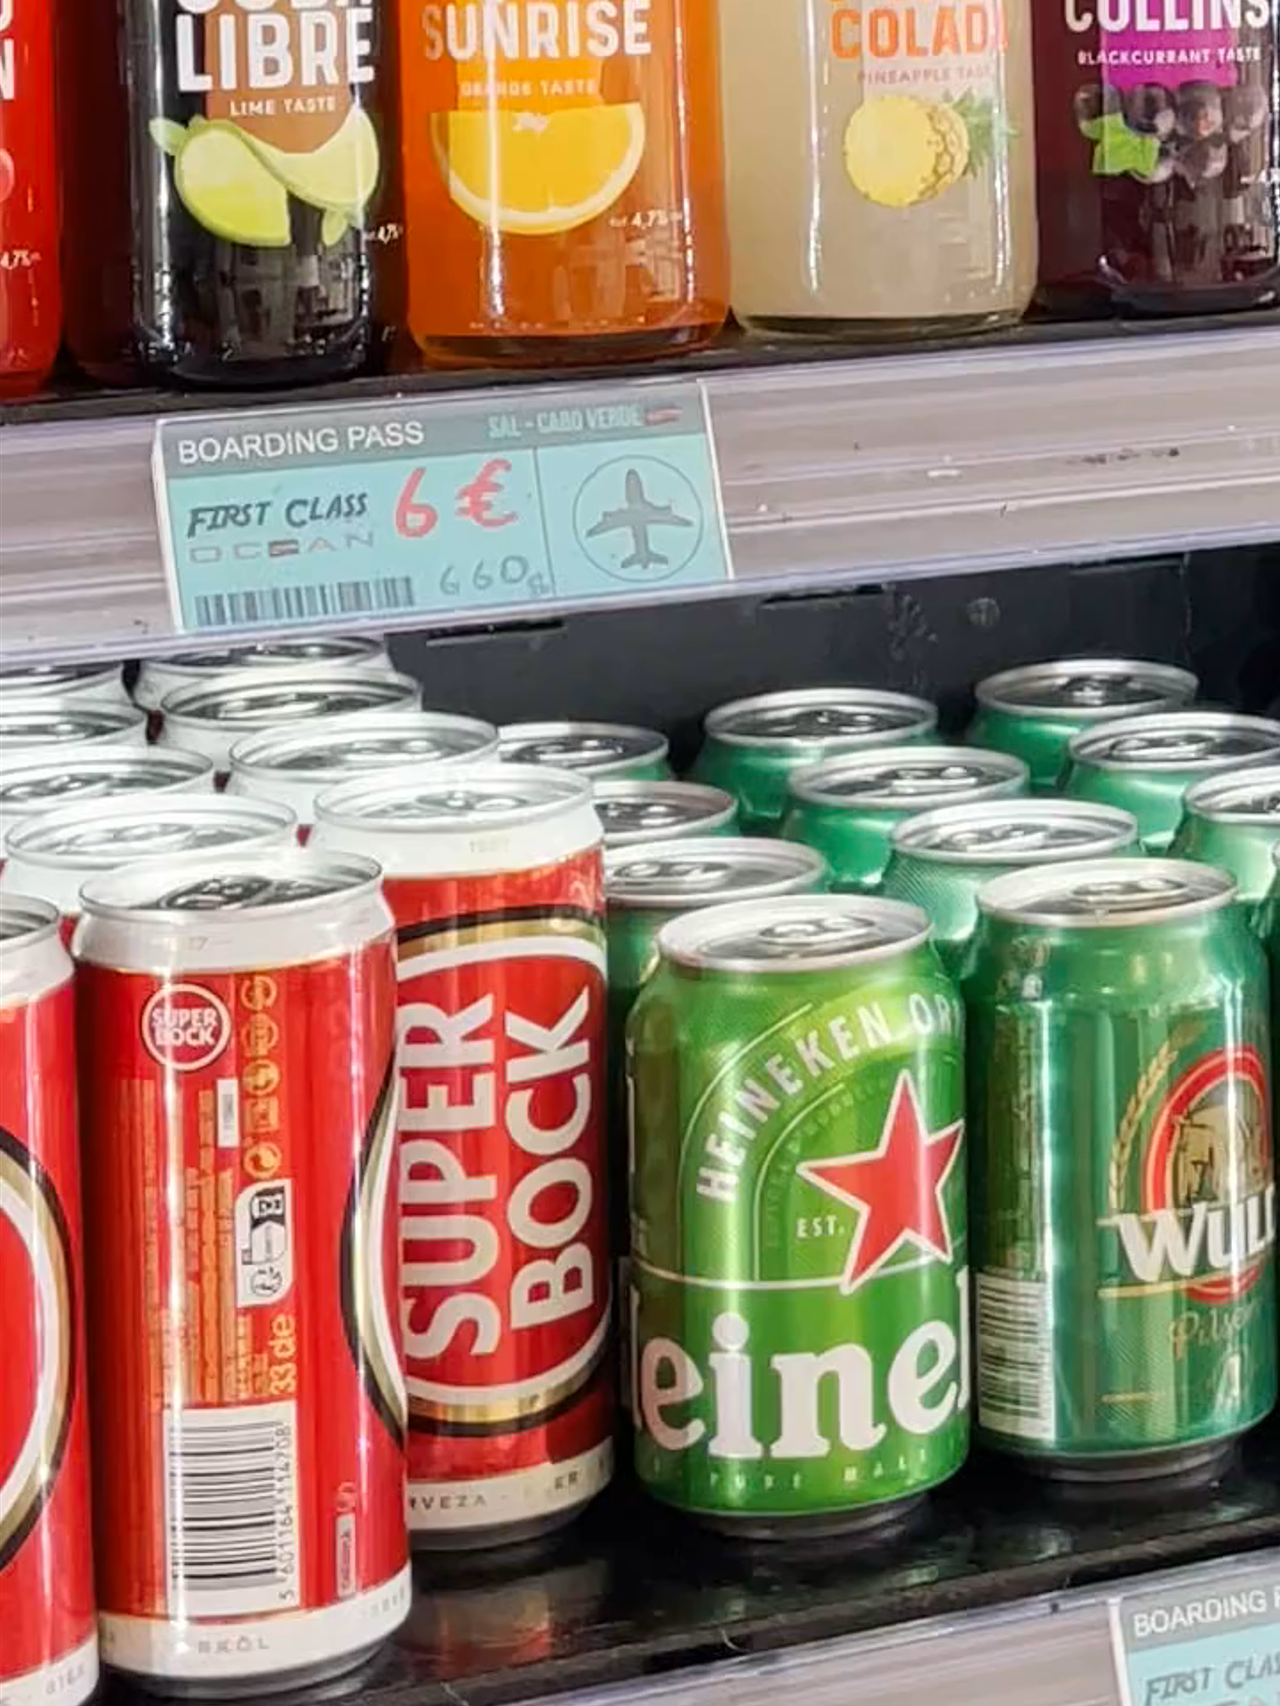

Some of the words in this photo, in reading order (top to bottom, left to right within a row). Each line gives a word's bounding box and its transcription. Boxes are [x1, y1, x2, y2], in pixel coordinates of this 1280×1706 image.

[175, 8, 375, 92] LIBRE
[830, 5, 1008, 60] COLADA
[1078, 48, 1211, 66] BLACKCURRANT
[1217, 45, 1261, 63] TASTE
[229, 99, 275, 117] LIME
[283, 95, 337, 115] TASTE
[539, 78, 599, 95] TASTE
[178, 422, 339, 464] BOARDING
[348, 420, 424, 450] PASS
[488, 415, 519, 439] SAL
[537, 410, 583, 434] CABO
[584, 405, 642, 430] VERDE
[187, 501, 272, 538] FIRST
[285, 492, 368, 528] CLASS
[150, 1005, 219, 1028] SUPER
[155, 1026, 216, 1047] BOCK
[696, 1001, 892, 1203] HEINEKEN
[398, 992, 500, 1359] SUPER
[504, 985, 595, 1332] BOCK
[796, 1214, 845, 1239] EST.
[1134, 1589, 1267, 1639] BOARDING
